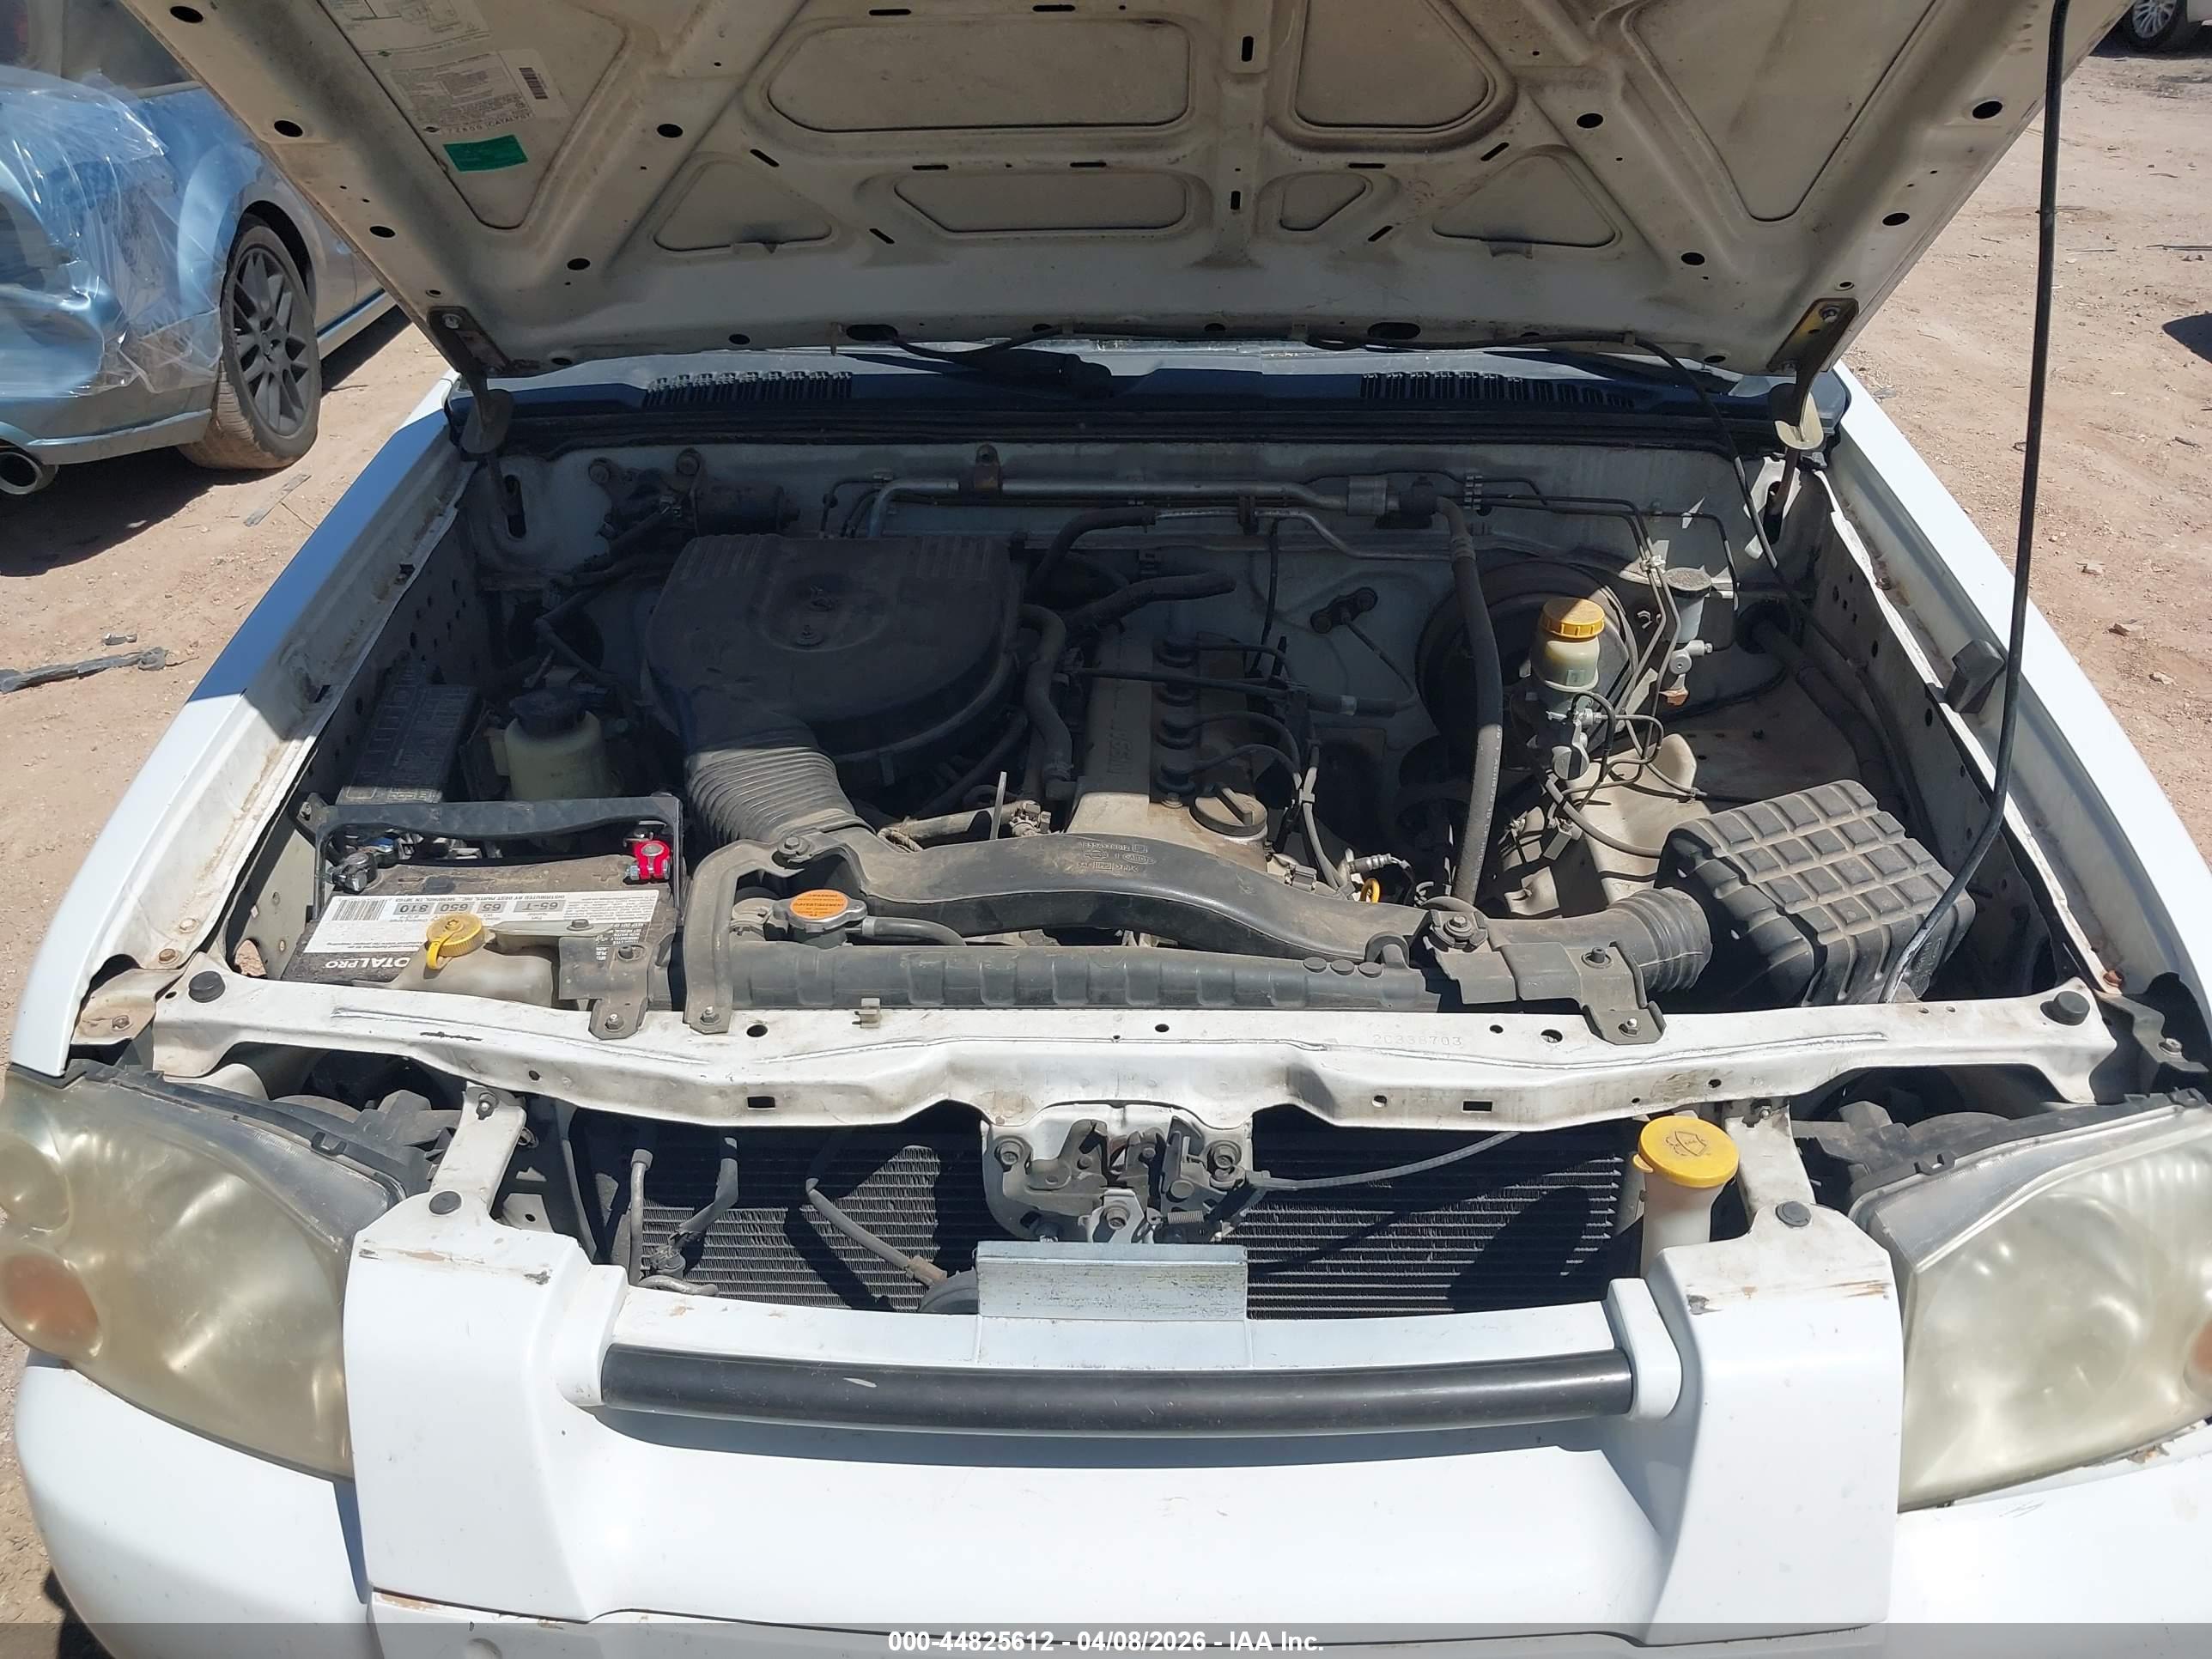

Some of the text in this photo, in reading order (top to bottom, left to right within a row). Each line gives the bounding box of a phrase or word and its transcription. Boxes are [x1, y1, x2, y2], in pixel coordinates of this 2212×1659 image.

[399, 903, 429, 913] 810
[441, 902, 469, 912] 650
[483, 902, 502, 912] 65
[522, 902, 558, 911] 65-T
[325, 957, 412, 969] OTALPRO
